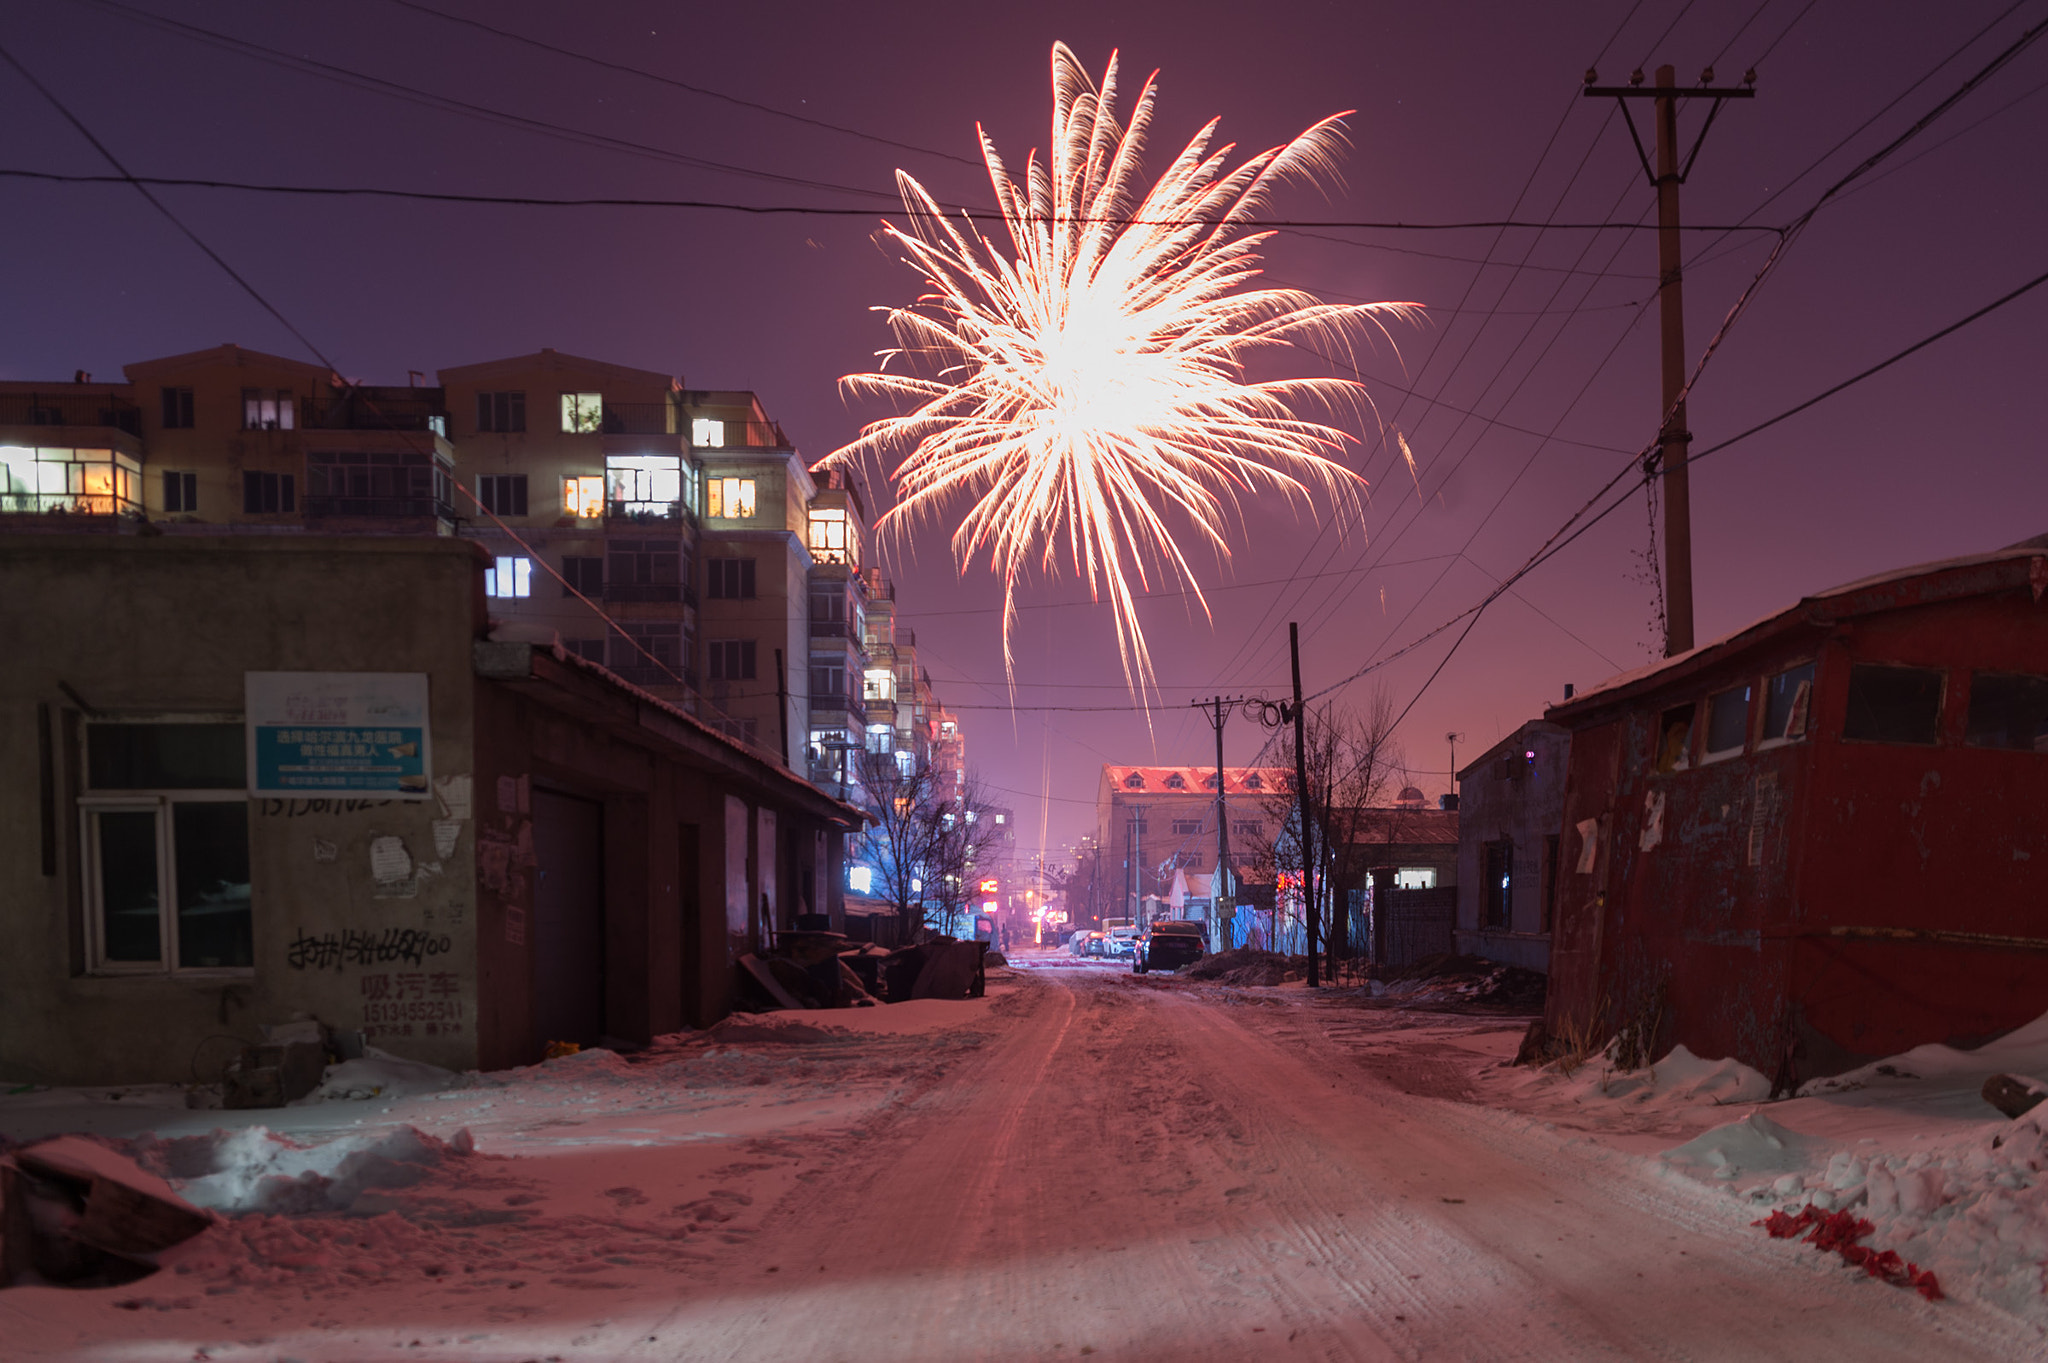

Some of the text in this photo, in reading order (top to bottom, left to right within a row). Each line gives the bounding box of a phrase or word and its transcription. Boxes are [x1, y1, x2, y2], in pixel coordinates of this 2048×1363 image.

[361, 972, 460, 1000] 吸污车
[363, 1000, 462, 1023] 15134552541
